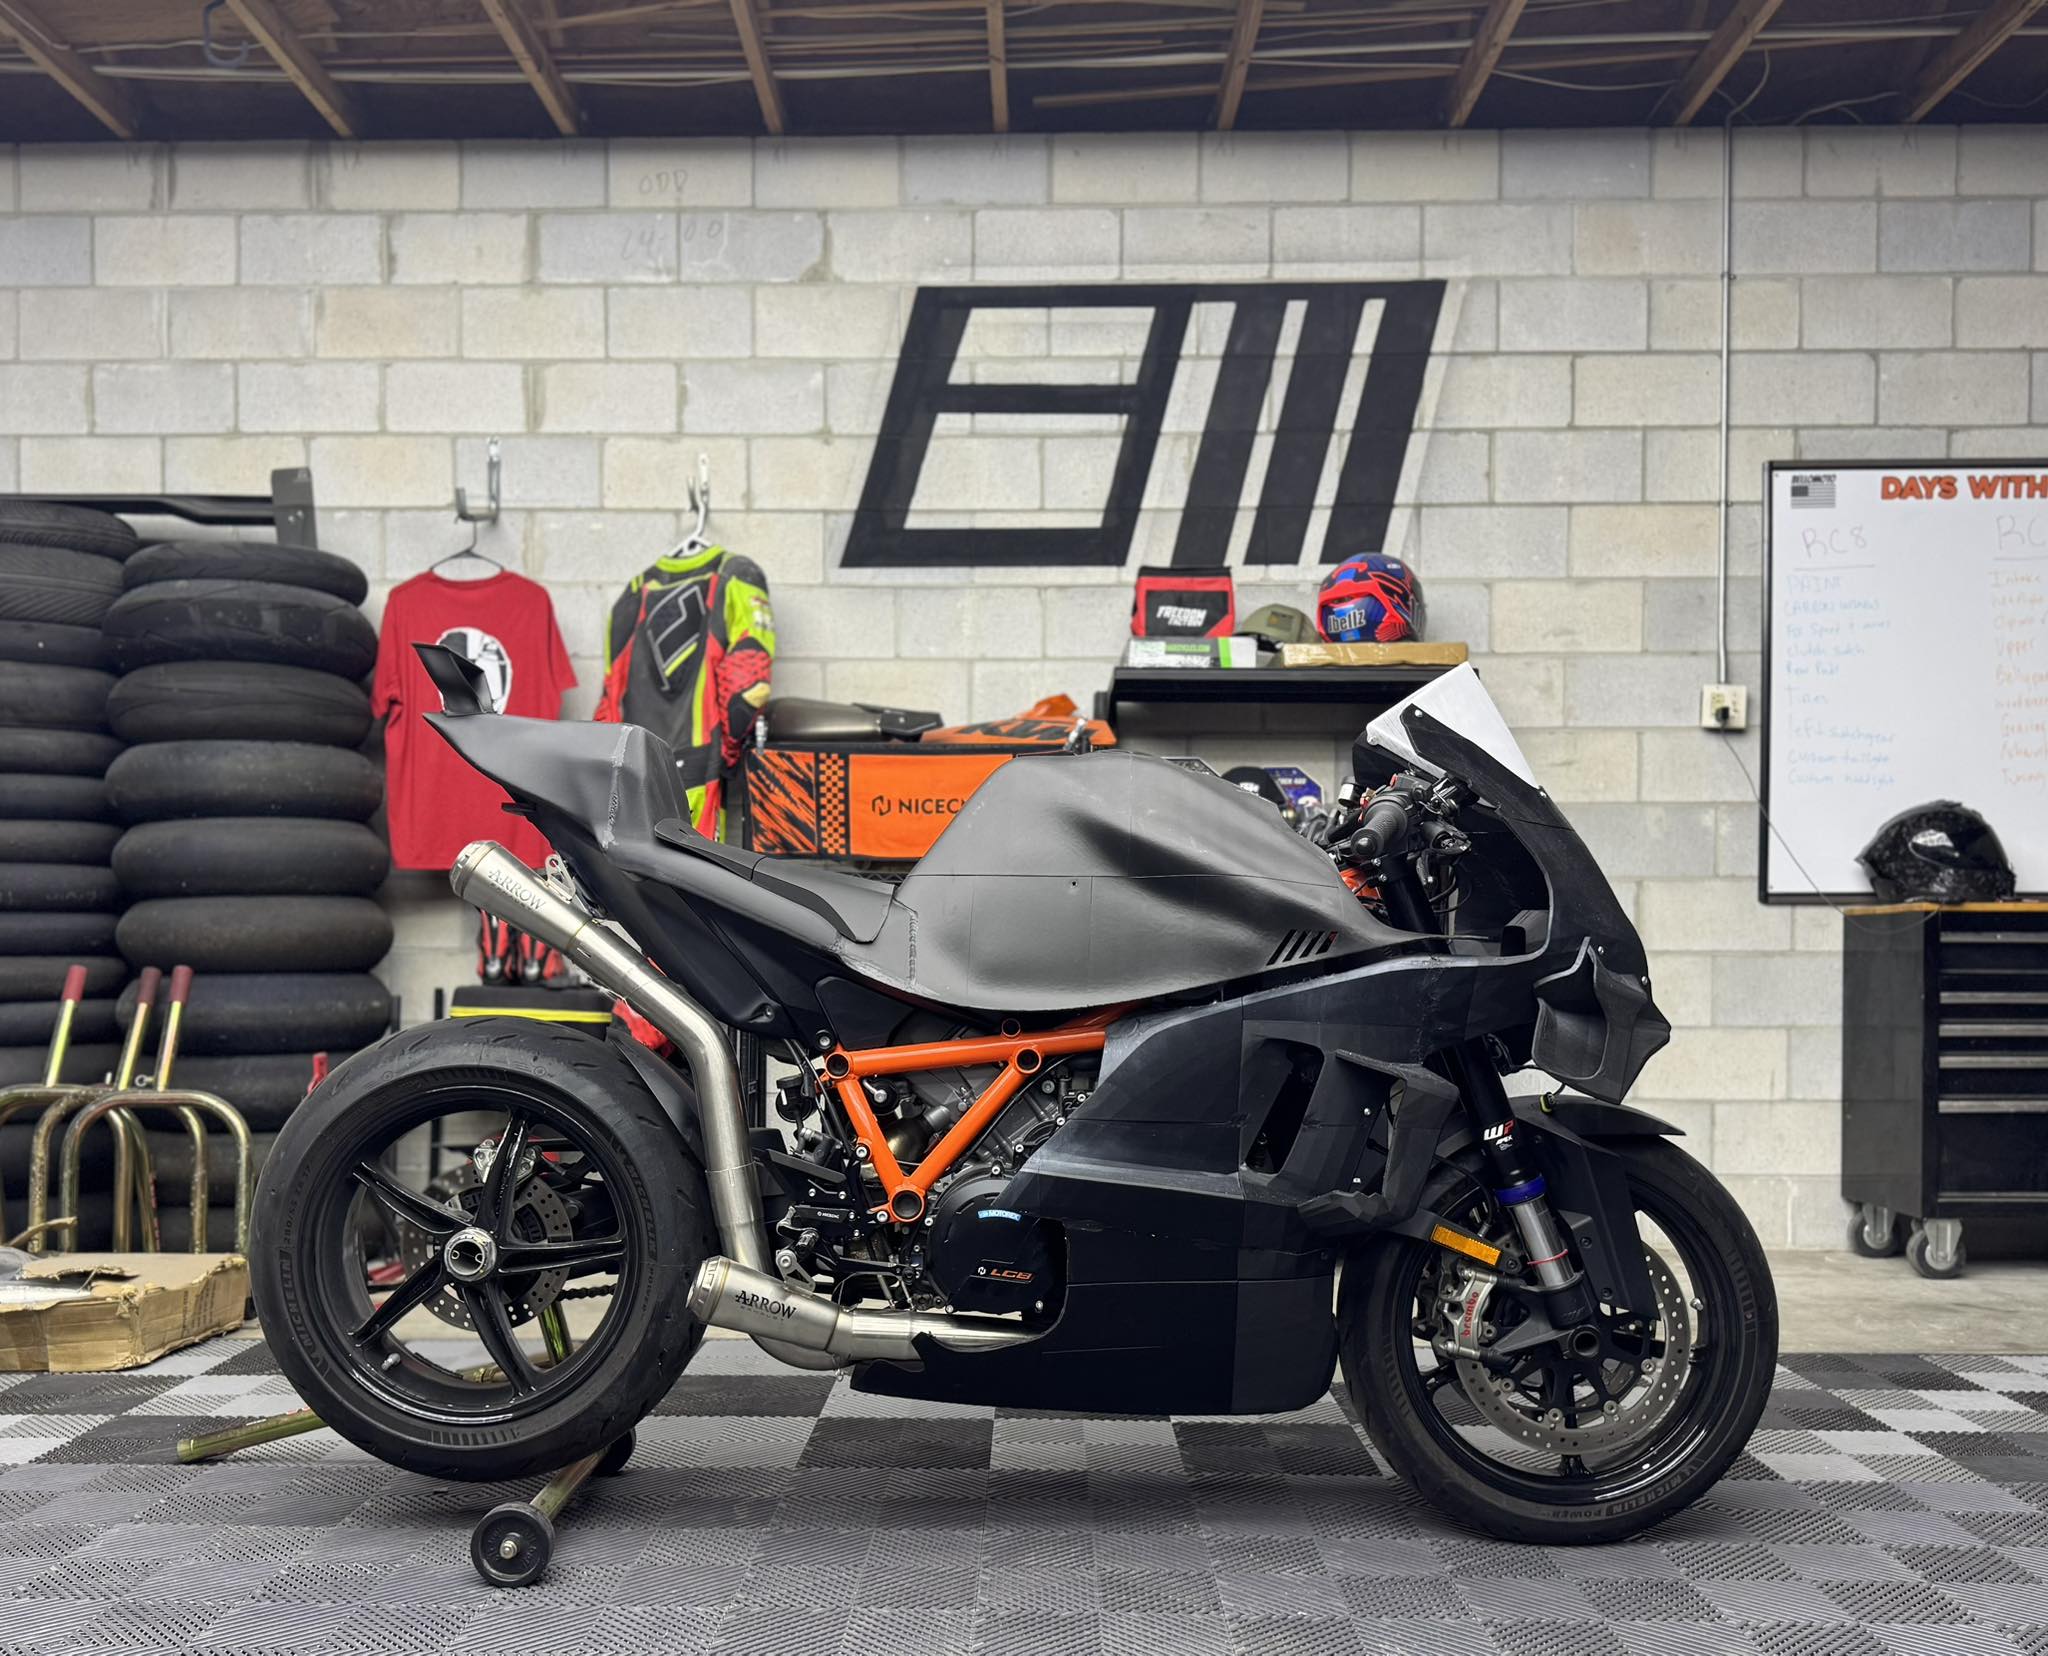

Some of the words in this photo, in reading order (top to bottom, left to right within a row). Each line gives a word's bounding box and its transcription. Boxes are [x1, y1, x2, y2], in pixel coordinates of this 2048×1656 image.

[1880, 476, 1958, 500] DAYS
[1156, 605, 1208, 620] FREEDOM
[899, 798, 965, 815] NICEC
[488, 869, 547, 912] ARROW
[1483, 1119, 1516, 1141] WP
[735, 1289, 797, 1319] ARROW
[1461, 1291, 1480, 1338] brembo
[1612, 1474, 1682, 1515] MICHELIN
